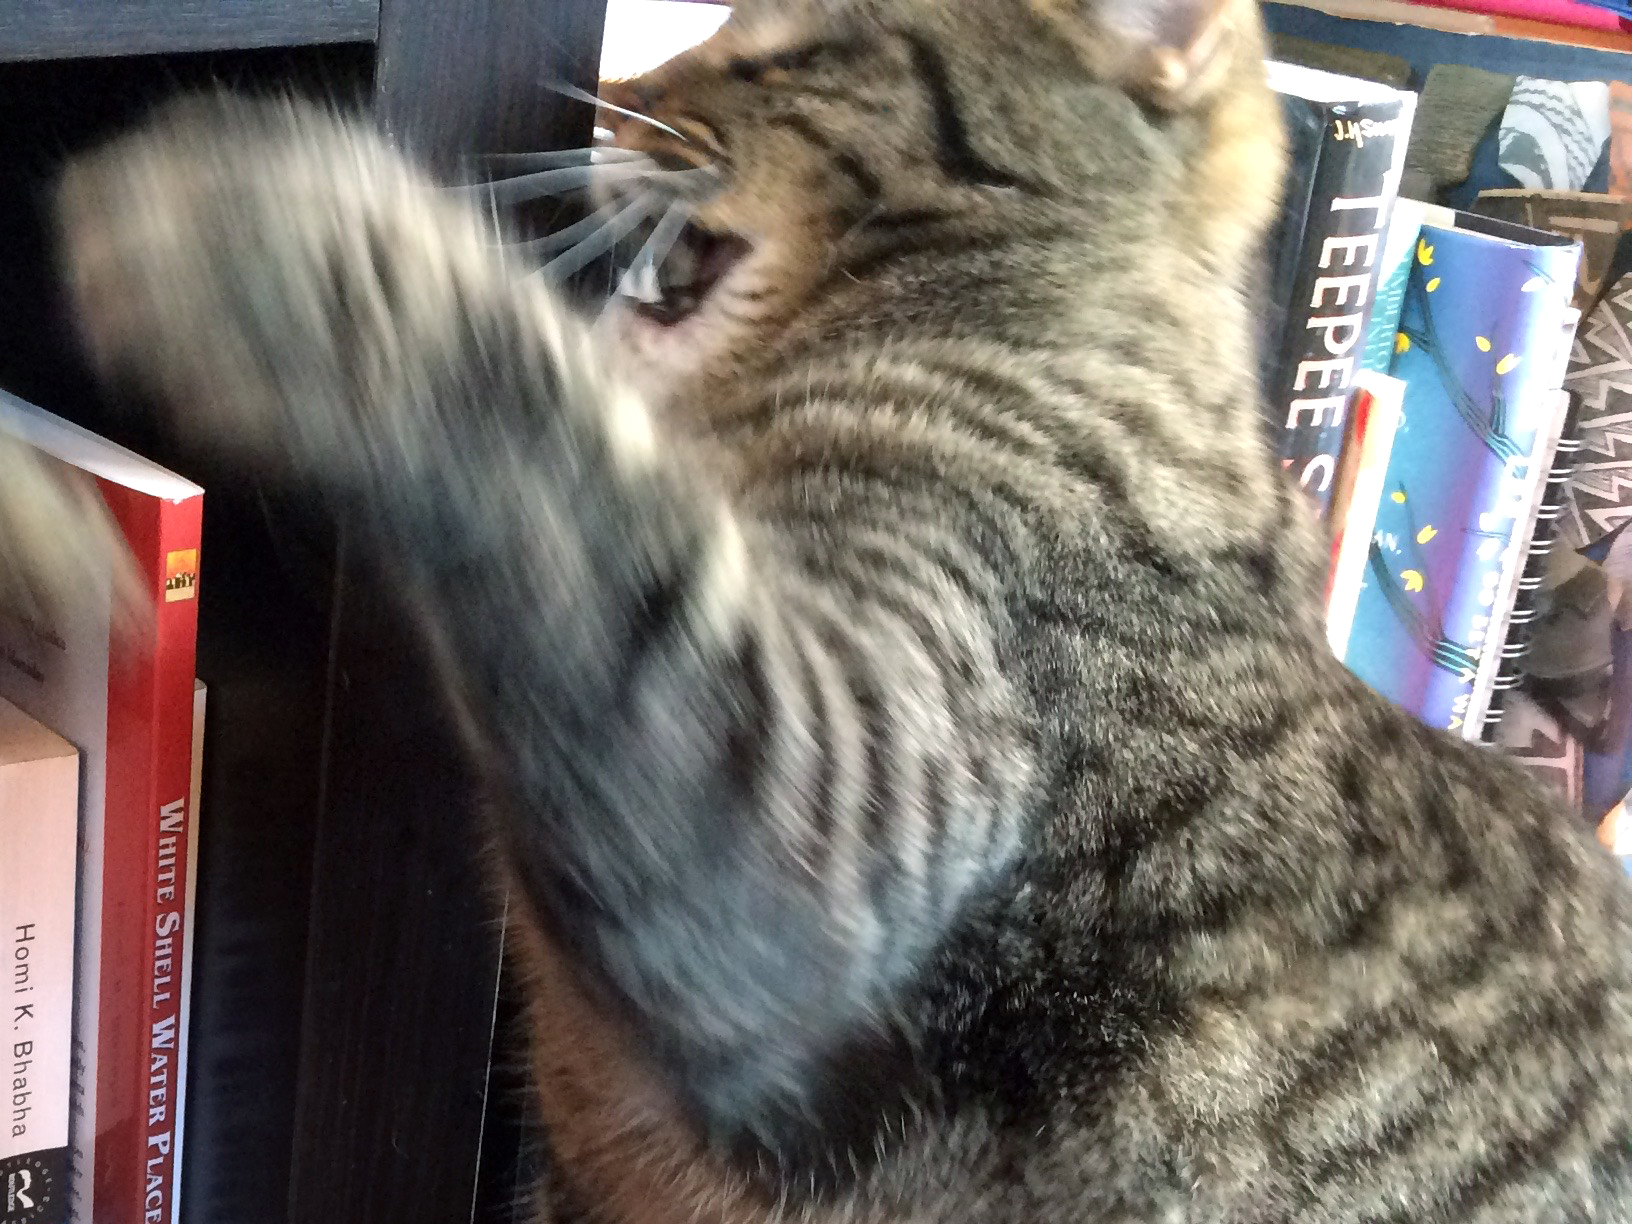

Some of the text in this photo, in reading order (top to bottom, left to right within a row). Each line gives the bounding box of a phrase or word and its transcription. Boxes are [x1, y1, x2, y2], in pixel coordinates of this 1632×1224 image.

[156, 796, 185, 904] WHITE
[14, 923, 35, 994] Homi
[152, 911, 181, 1010] SHELL
[13, 1003, 34, 1031] K.
[12, 1040, 33, 1138] Bhabha
[148, 1013, 176, 1127] WATER
